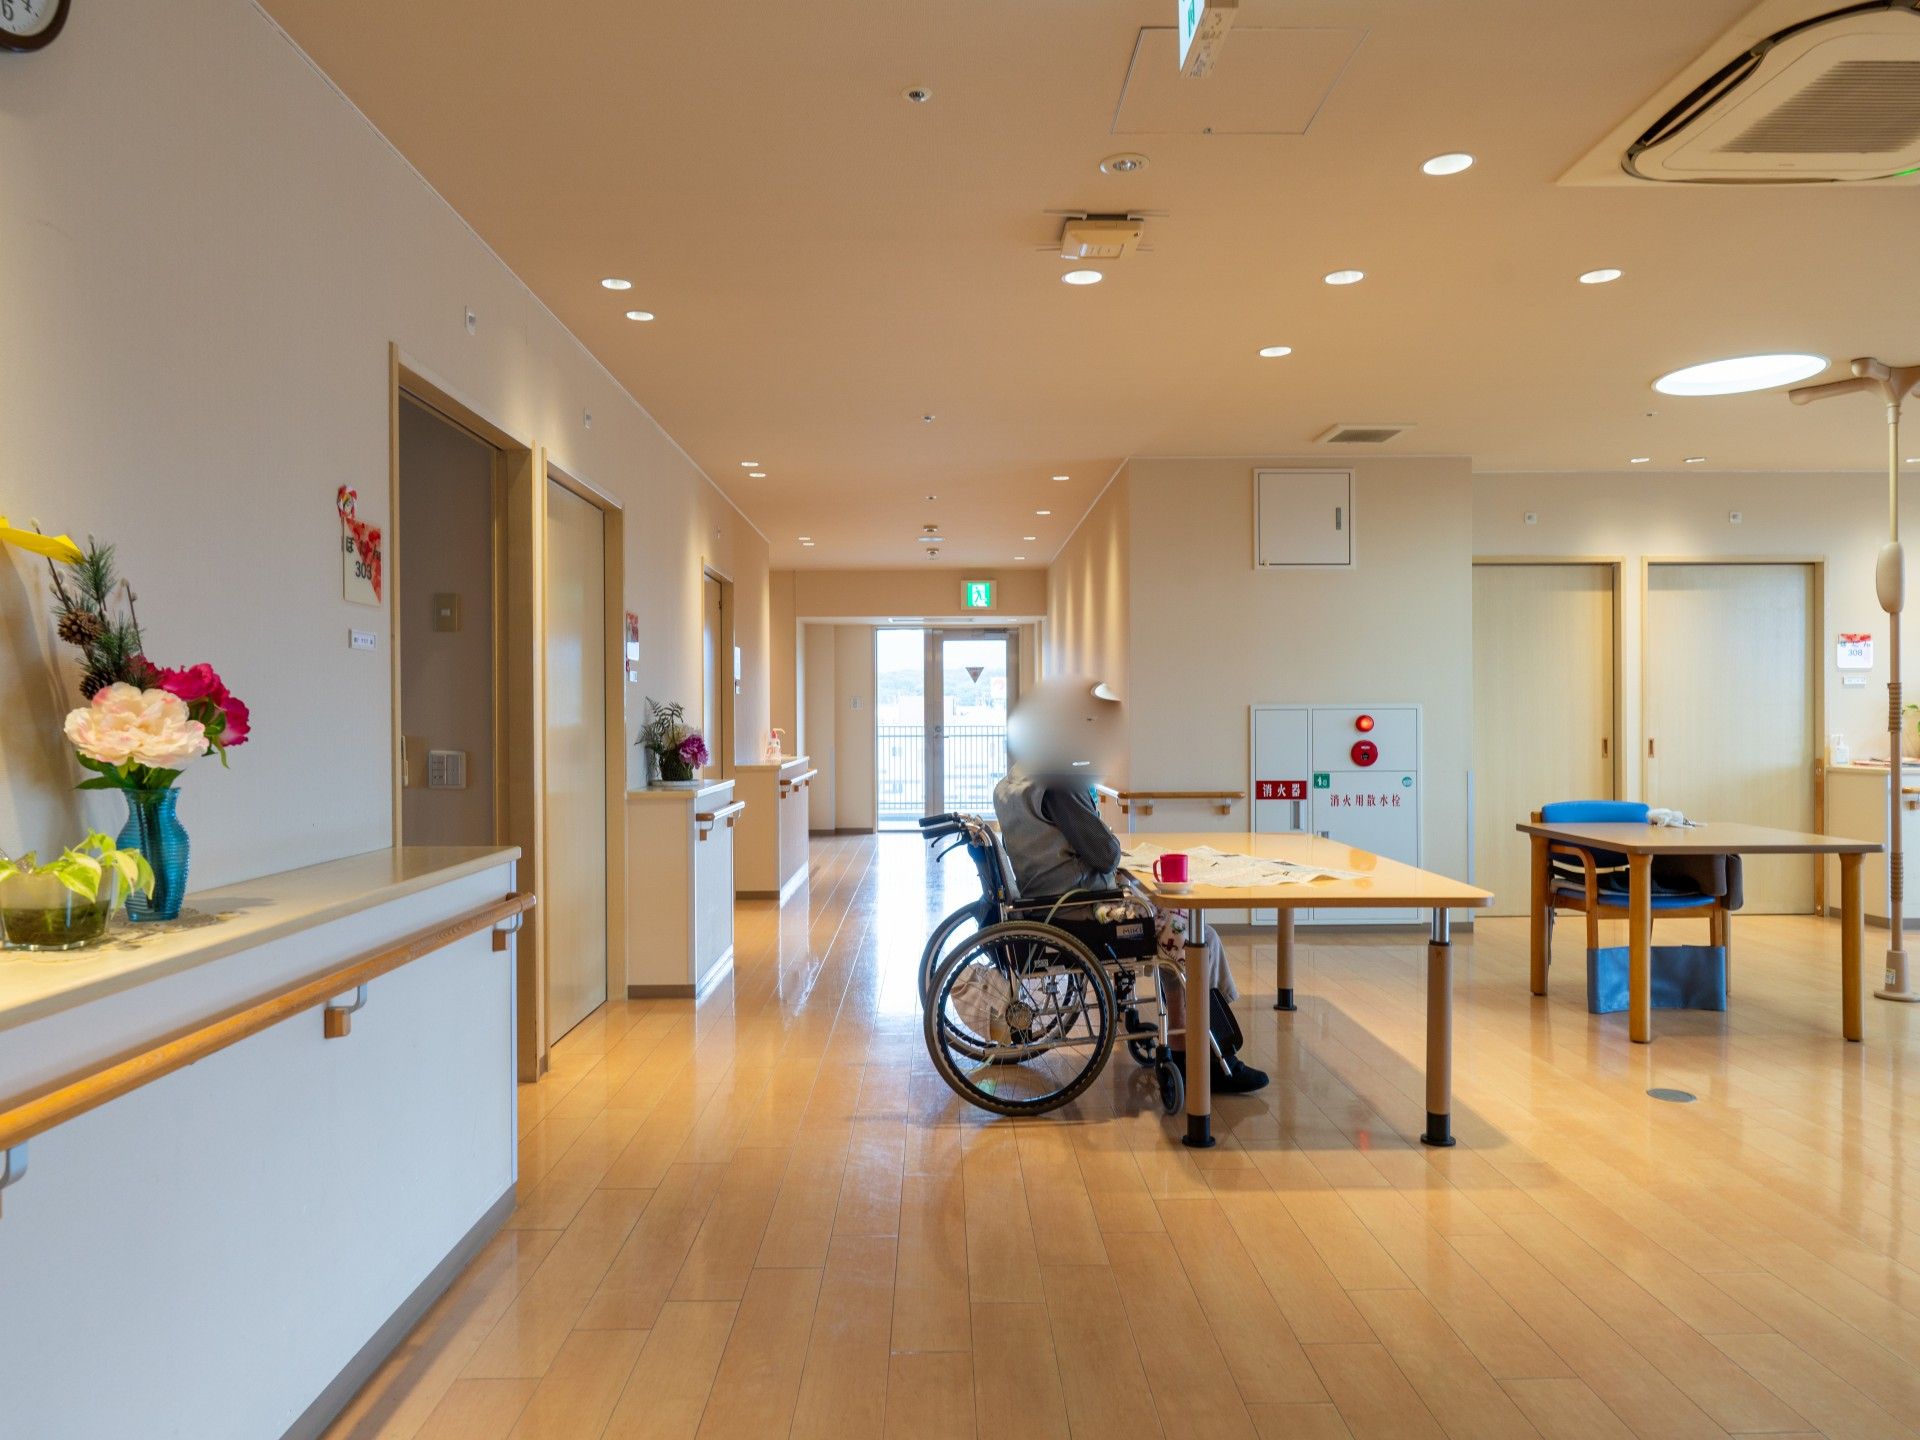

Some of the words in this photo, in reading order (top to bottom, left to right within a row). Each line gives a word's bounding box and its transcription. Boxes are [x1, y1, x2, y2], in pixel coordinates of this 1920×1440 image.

[355, 560, 374, 580] 303
[1263, 783, 1301, 797] 消火器
[1330, 794, 1400, 807] 消火用散水栓
